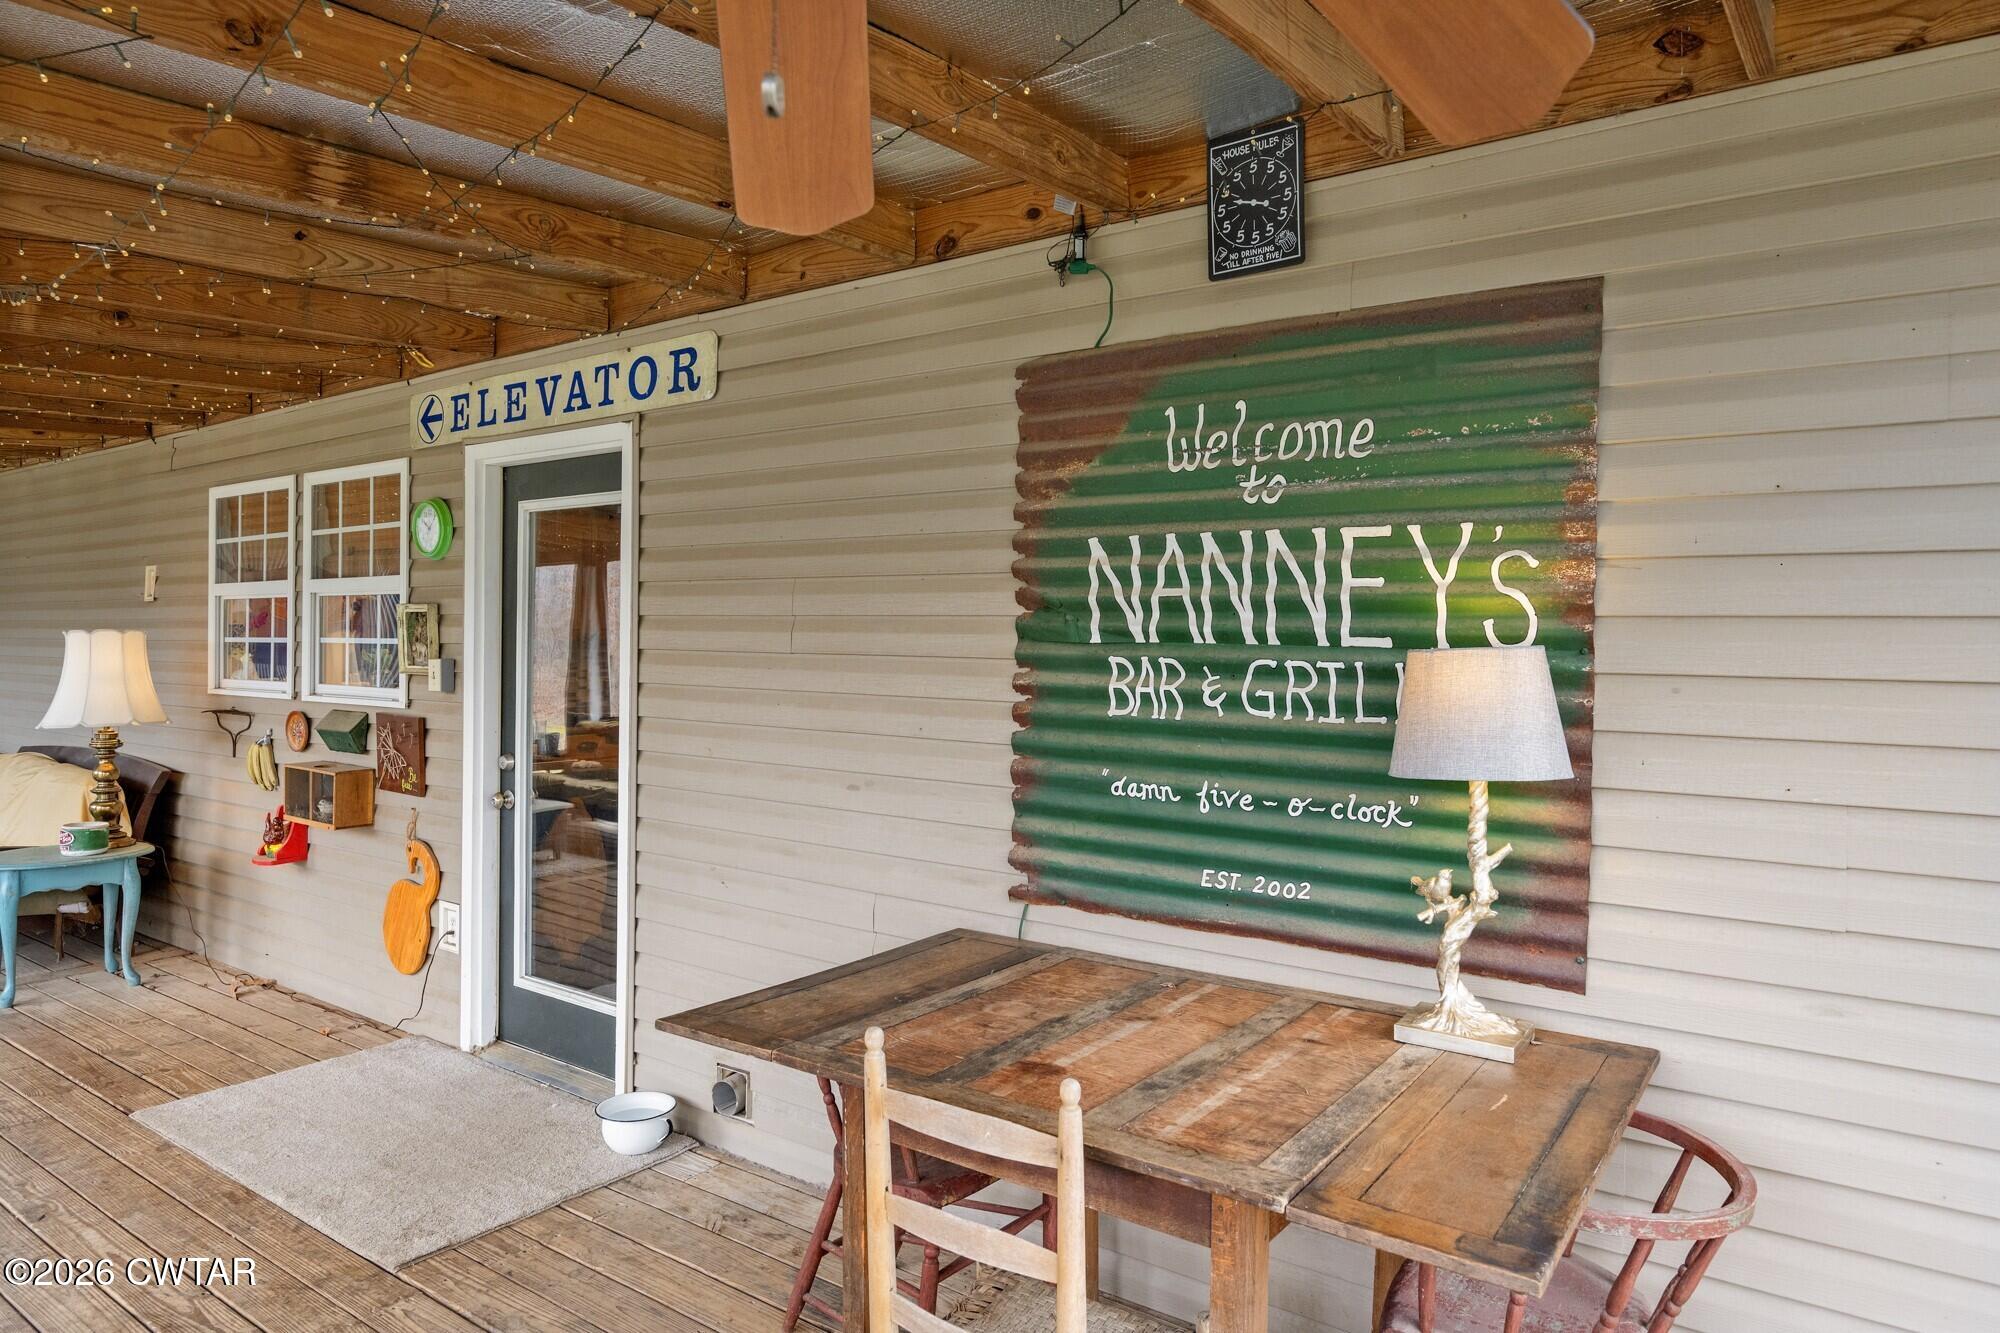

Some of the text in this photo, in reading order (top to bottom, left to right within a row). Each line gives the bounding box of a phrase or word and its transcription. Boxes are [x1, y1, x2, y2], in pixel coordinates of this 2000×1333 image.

[1222, 144, 1250, 160] HOUSE
[1249, 159, 1258, 175] 5
[1266, 160, 1275, 174] 5
[1233, 170, 1242, 182] 5
[1278, 170, 1287, 184] 5
[1283, 187, 1292, 201] 5
[1217, 204, 1226, 218] 5
[1277, 206, 1288, 220] 5
[1222, 220, 1231, 233] 5
[1265, 223, 1274, 236] 5
[1236, 230, 1245, 243] 5
[1250, 230, 1260, 244] 5
[1229, 244, 1275, 261] NO DRINKING
[1242, 255, 1264, 266] AFTER
[450, 346, 702, 432] ELEVATOR
[1164, 400, 1375, 473] Welcome
[1239, 465, 1287, 504] to
[1107, 656, 1185, 720] BAR
[1202, 666, 1227, 717] &
[1200, 869, 1312, 900] EST. 2002
